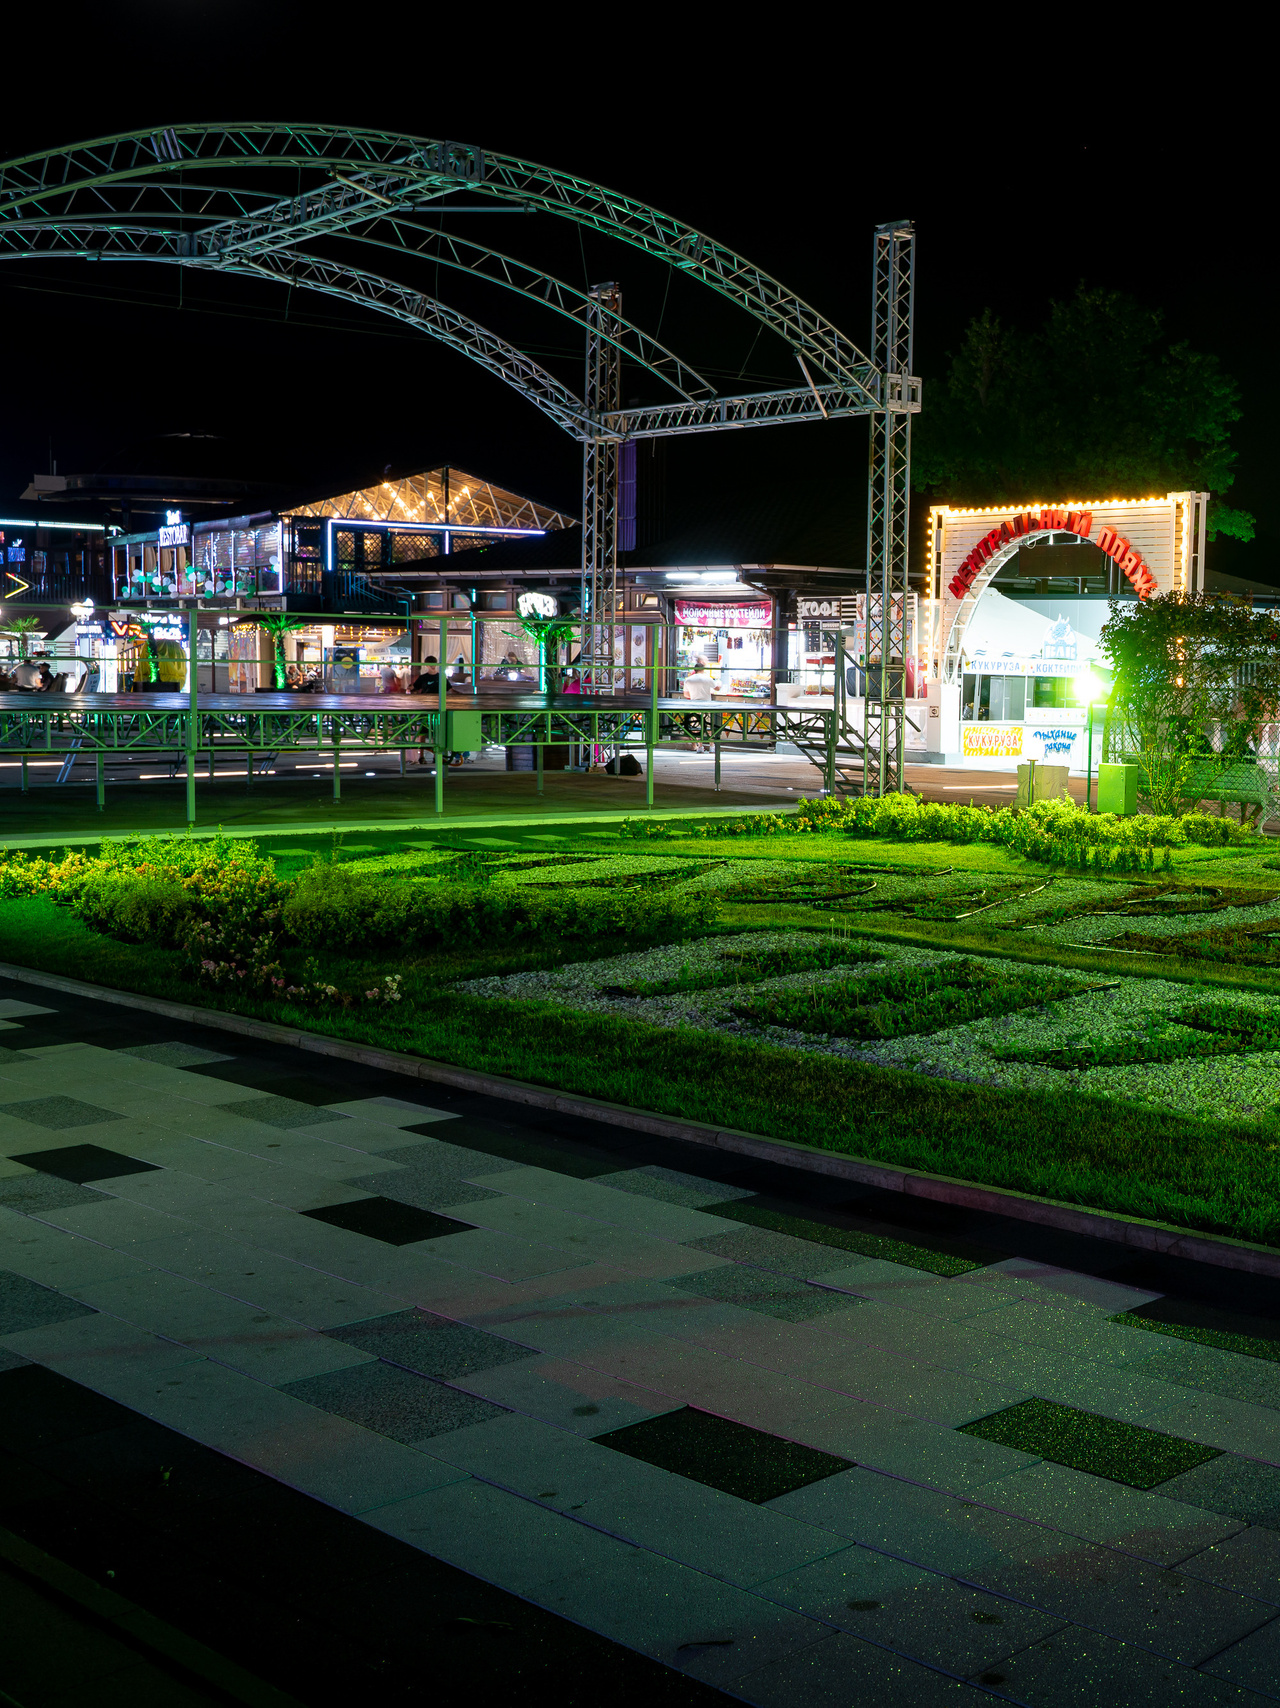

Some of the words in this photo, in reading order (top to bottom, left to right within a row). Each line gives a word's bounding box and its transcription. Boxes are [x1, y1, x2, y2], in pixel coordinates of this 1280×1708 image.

[948, 508, 1093, 600] ЦЕНТРАЛЬНЫЙ
[1095, 525, 1159, 602] ПЛЯЖ
[682, 607, 724, 619] МОЛОЧНЫЕ
[725, 606, 766, 619] КОКТЕЙЛИ
[801, 600, 840, 617] КОФЕ
[971, 661, 1020, 671] КУКУРУЗА
[968, 735, 1018, 747] КУКУРУЗА
